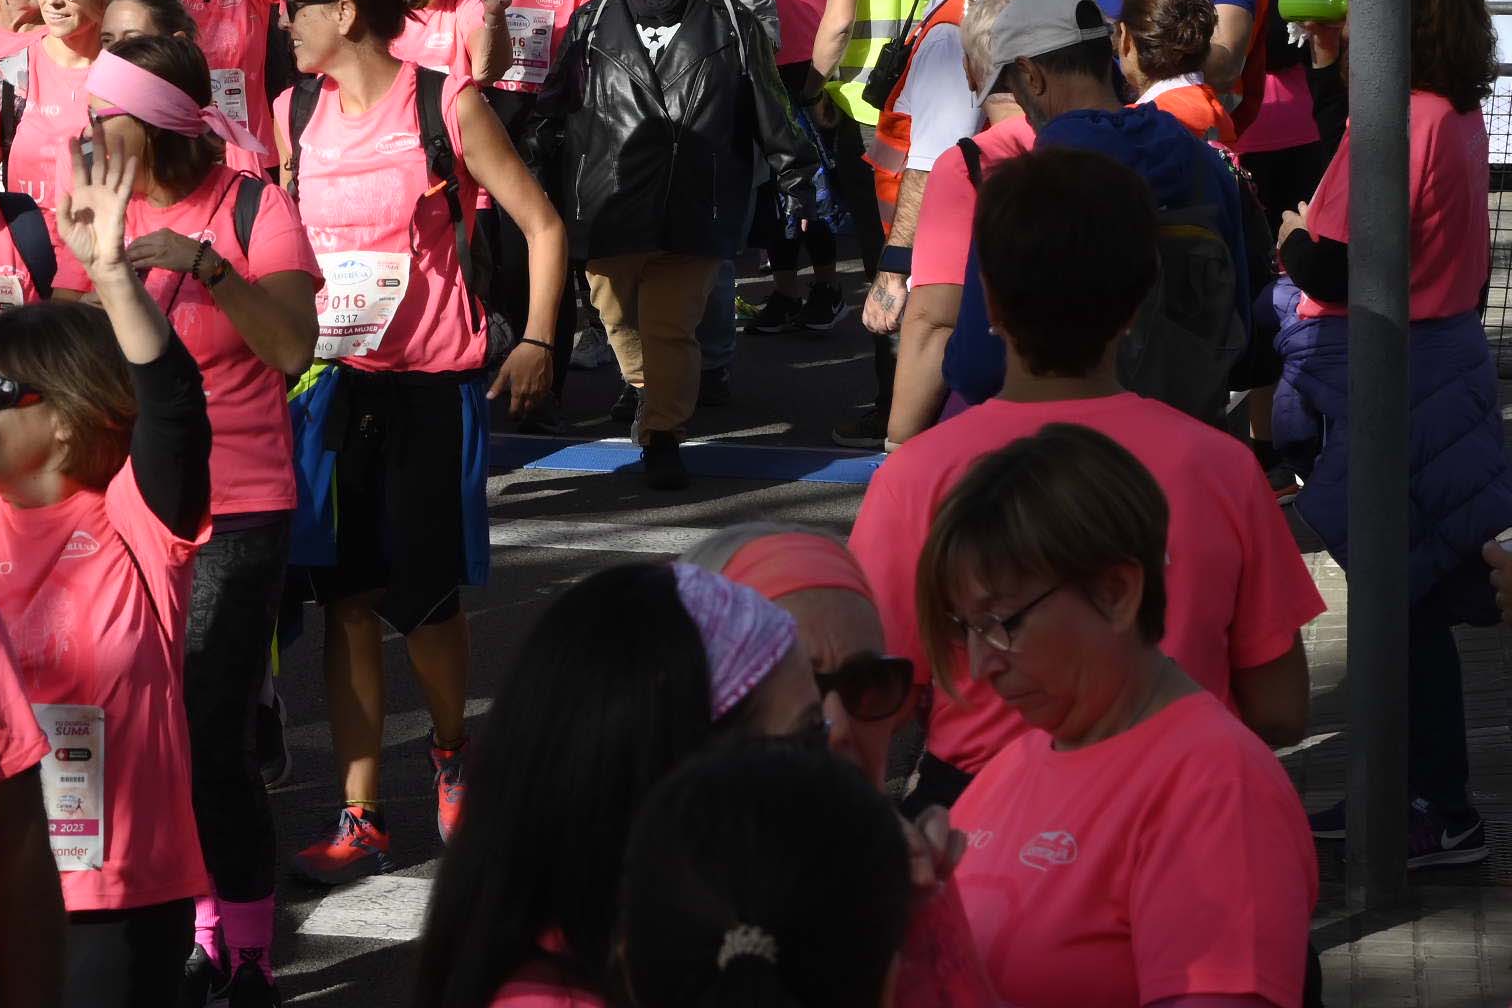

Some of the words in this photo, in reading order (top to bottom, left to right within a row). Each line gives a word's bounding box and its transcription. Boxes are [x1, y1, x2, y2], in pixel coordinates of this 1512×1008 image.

[511, 37, 525, 47] 16
[332, 294, 366, 309] 016
[55, 727, 90, 735] SUMA
[61, 824, 85, 832] 2023
